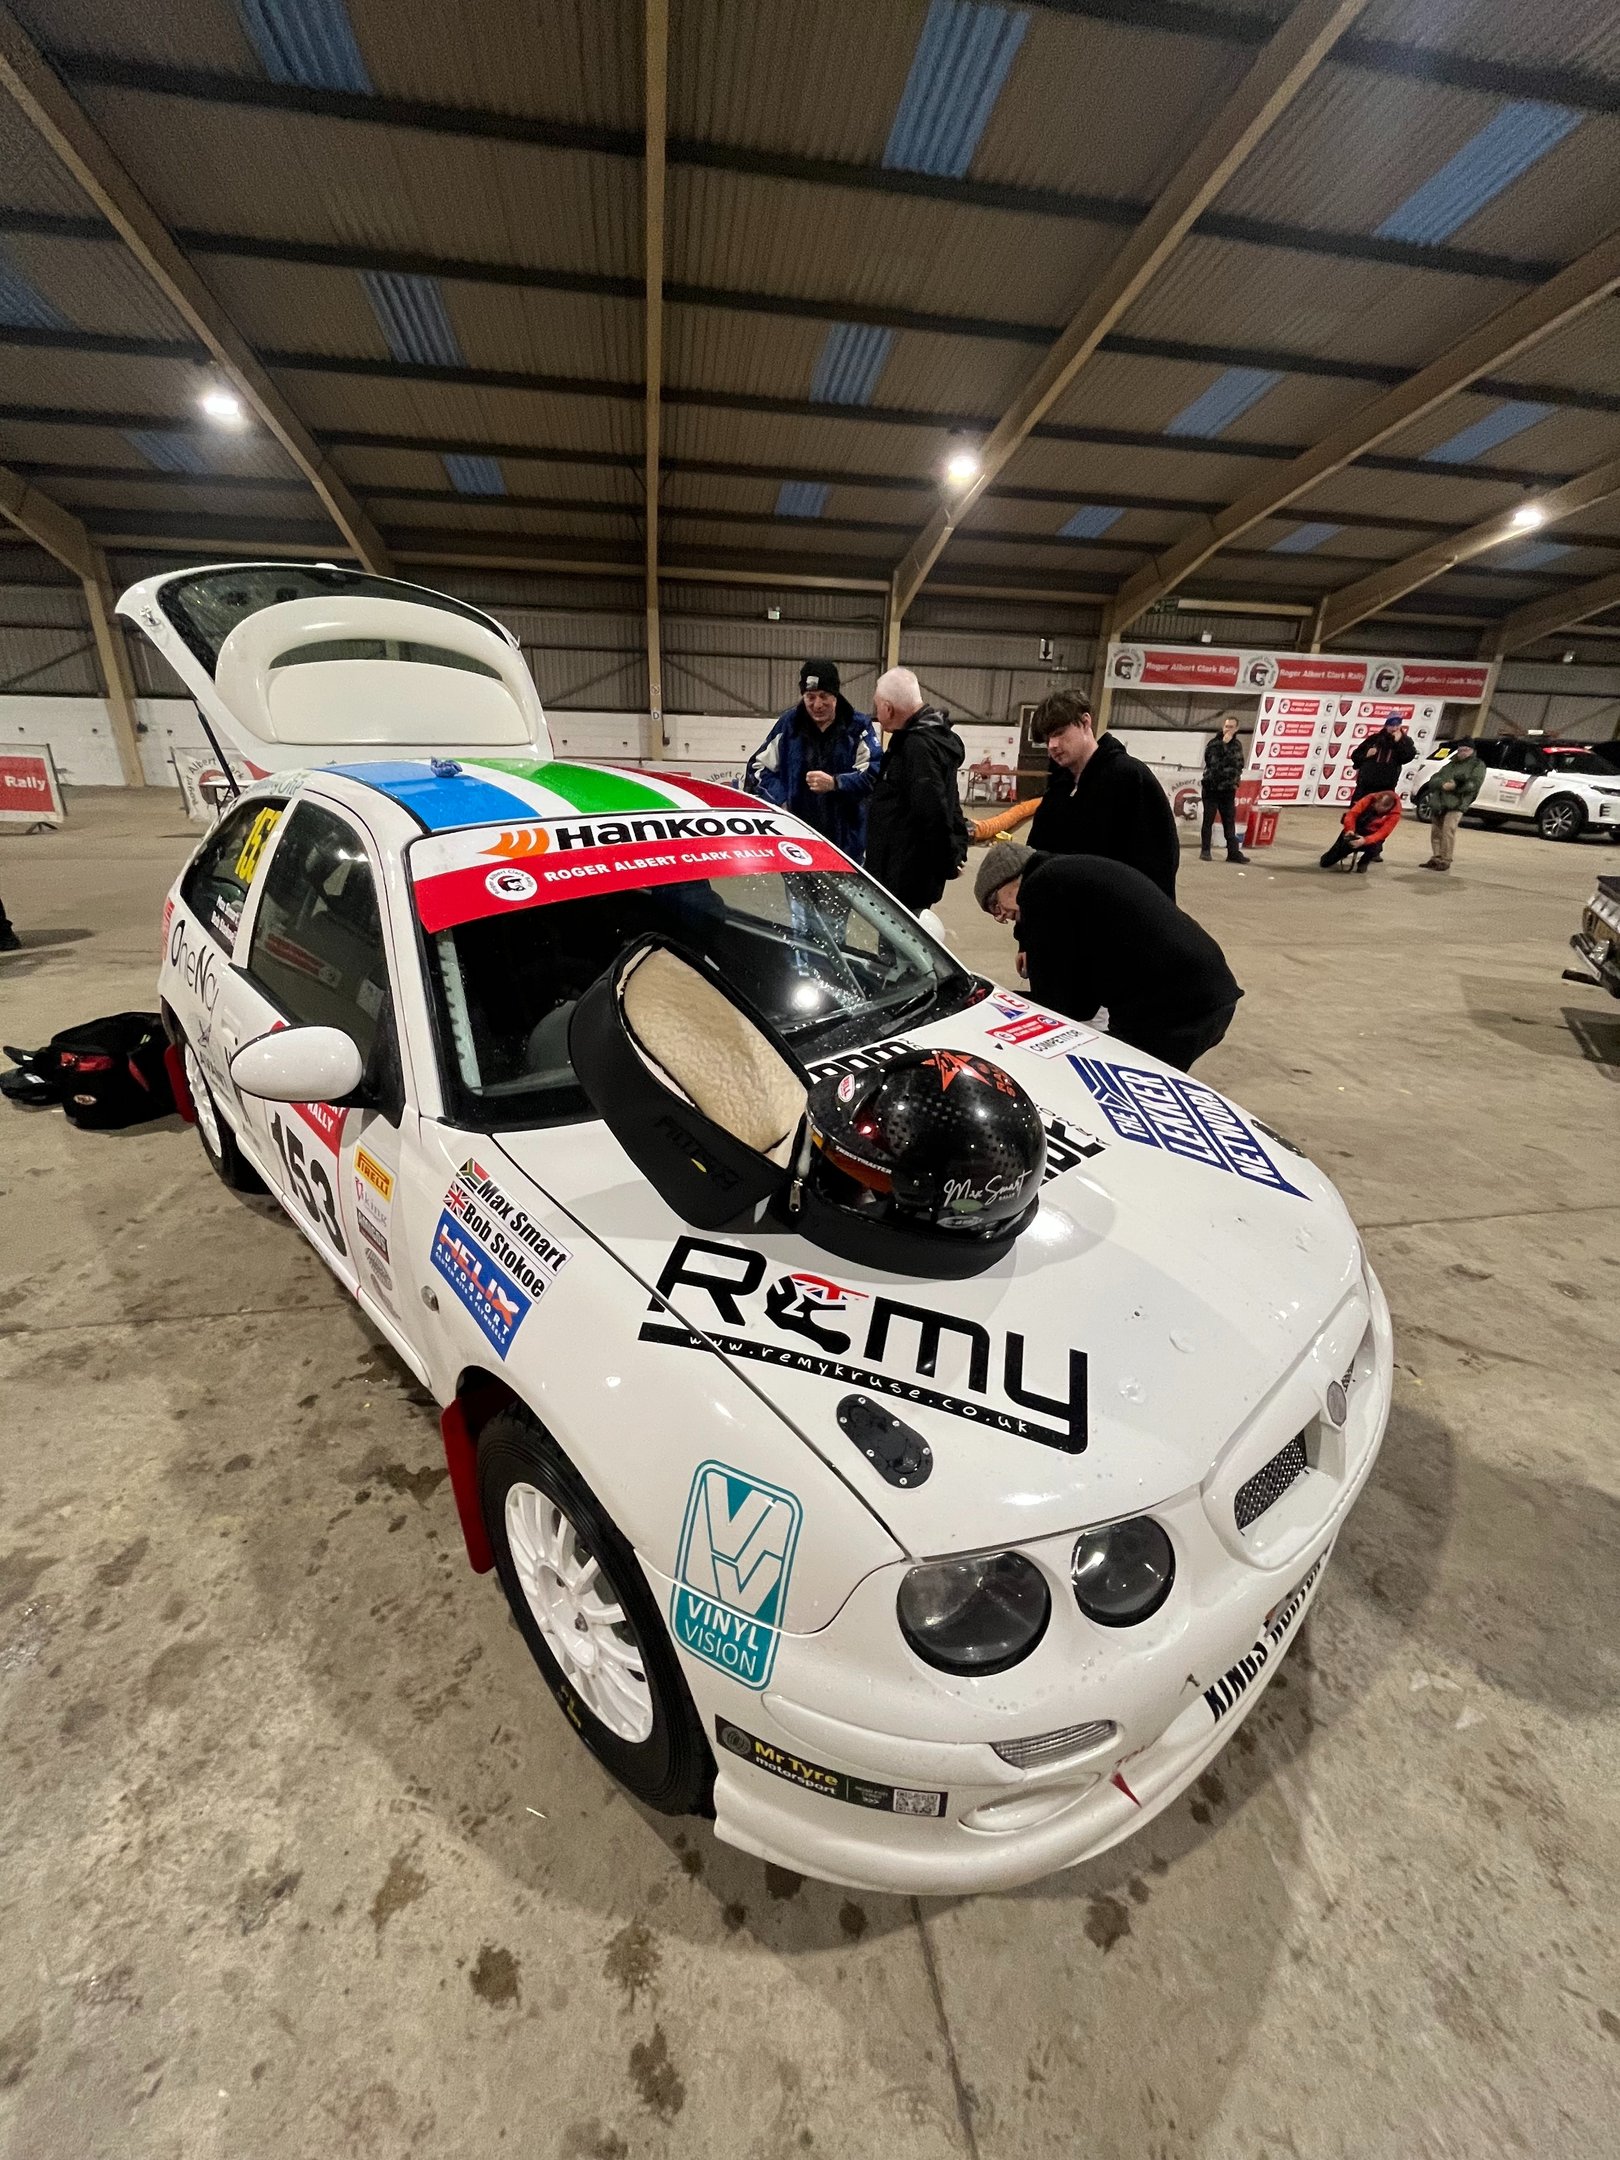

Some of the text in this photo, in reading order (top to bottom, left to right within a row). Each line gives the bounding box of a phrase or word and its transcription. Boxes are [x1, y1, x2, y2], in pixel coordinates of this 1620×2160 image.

[1146, 662, 1238, 675] Roger Albert Clark Rally
[1279, 668, 1301, 678] Roger
[1327, 670, 1345, 679] Clark
[4, 775, 46, 791] Rally
[188, 757, 216, 774] Albert
[543, 863, 612, 882] ROGER
[614, 855, 677, 872] ALBERT
[682, 852, 731, 863] CLARK
[735, 849, 775, 860] RALLY
[1029, 1029, 1081, 1052] COMPETITOR
[1117, 1107, 1150, 1139] THE
[1118, 1069, 1221, 1166] LEKKER
[1176, 1080, 1281, 1185] NETWORK
[270, 1110, 347, 1257] 153
[357, 1151, 390, 1197] PIRELLI
[477, 1179, 569, 1273] Max Smart
[462, 1204, 545, 1299] Bob Stokoe
[436, 1244, 510, 1336] AUTOSPORT
[438, 1223, 520, 1327] HELIX
[474, 1301, 506, 1345] FLYWHEELS
[689, 1335, 1029, 1435] www.remykruse.co.uk
[688, 1595, 760, 1651] VINYL
[684, 1621, 758, 1677] VISION
[755, 1741, 839, 1786] Mr Tyre
[755, 1756, 836, 1795] motorsport
